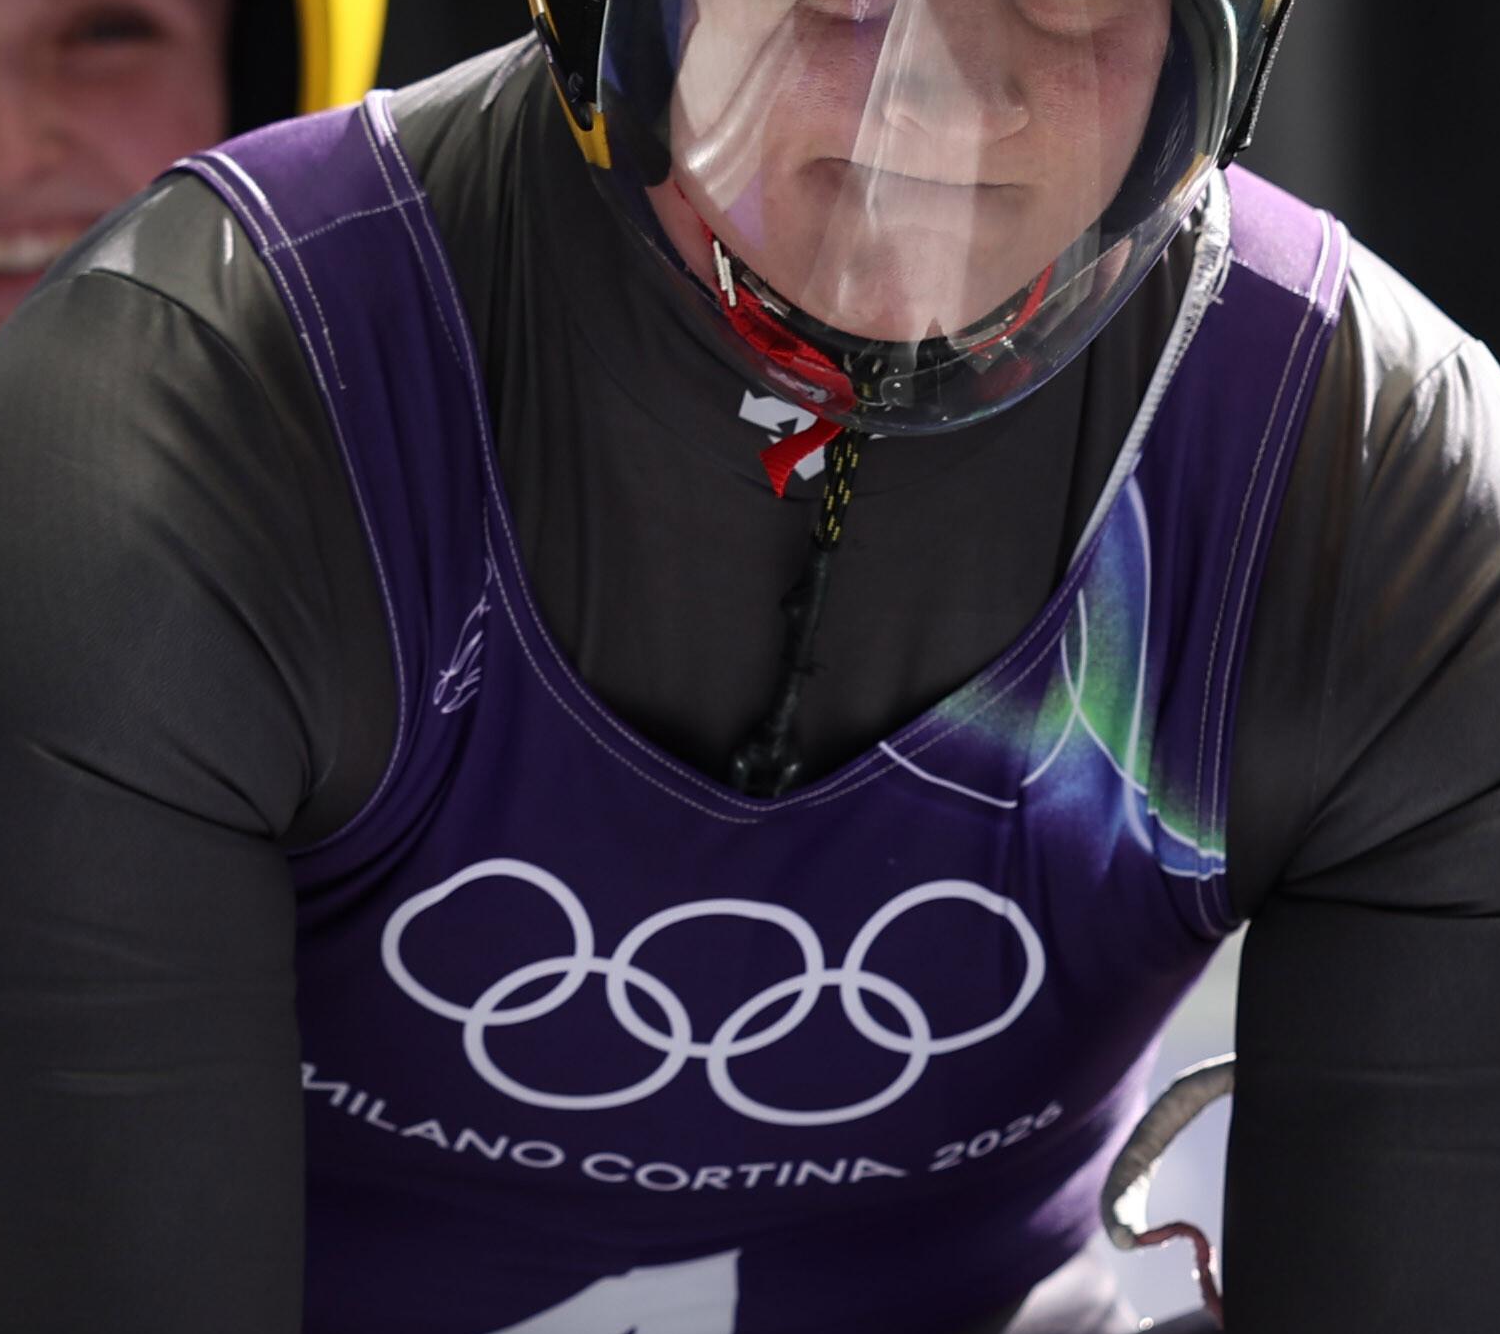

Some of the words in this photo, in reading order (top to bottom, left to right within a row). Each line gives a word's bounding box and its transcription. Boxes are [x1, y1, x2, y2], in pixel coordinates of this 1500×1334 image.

[301, 1061, 566, 1169] MILANO
[581, 1152, 909, 1193] CORTINA
[928, 1100, 1065, 1172] 2026
